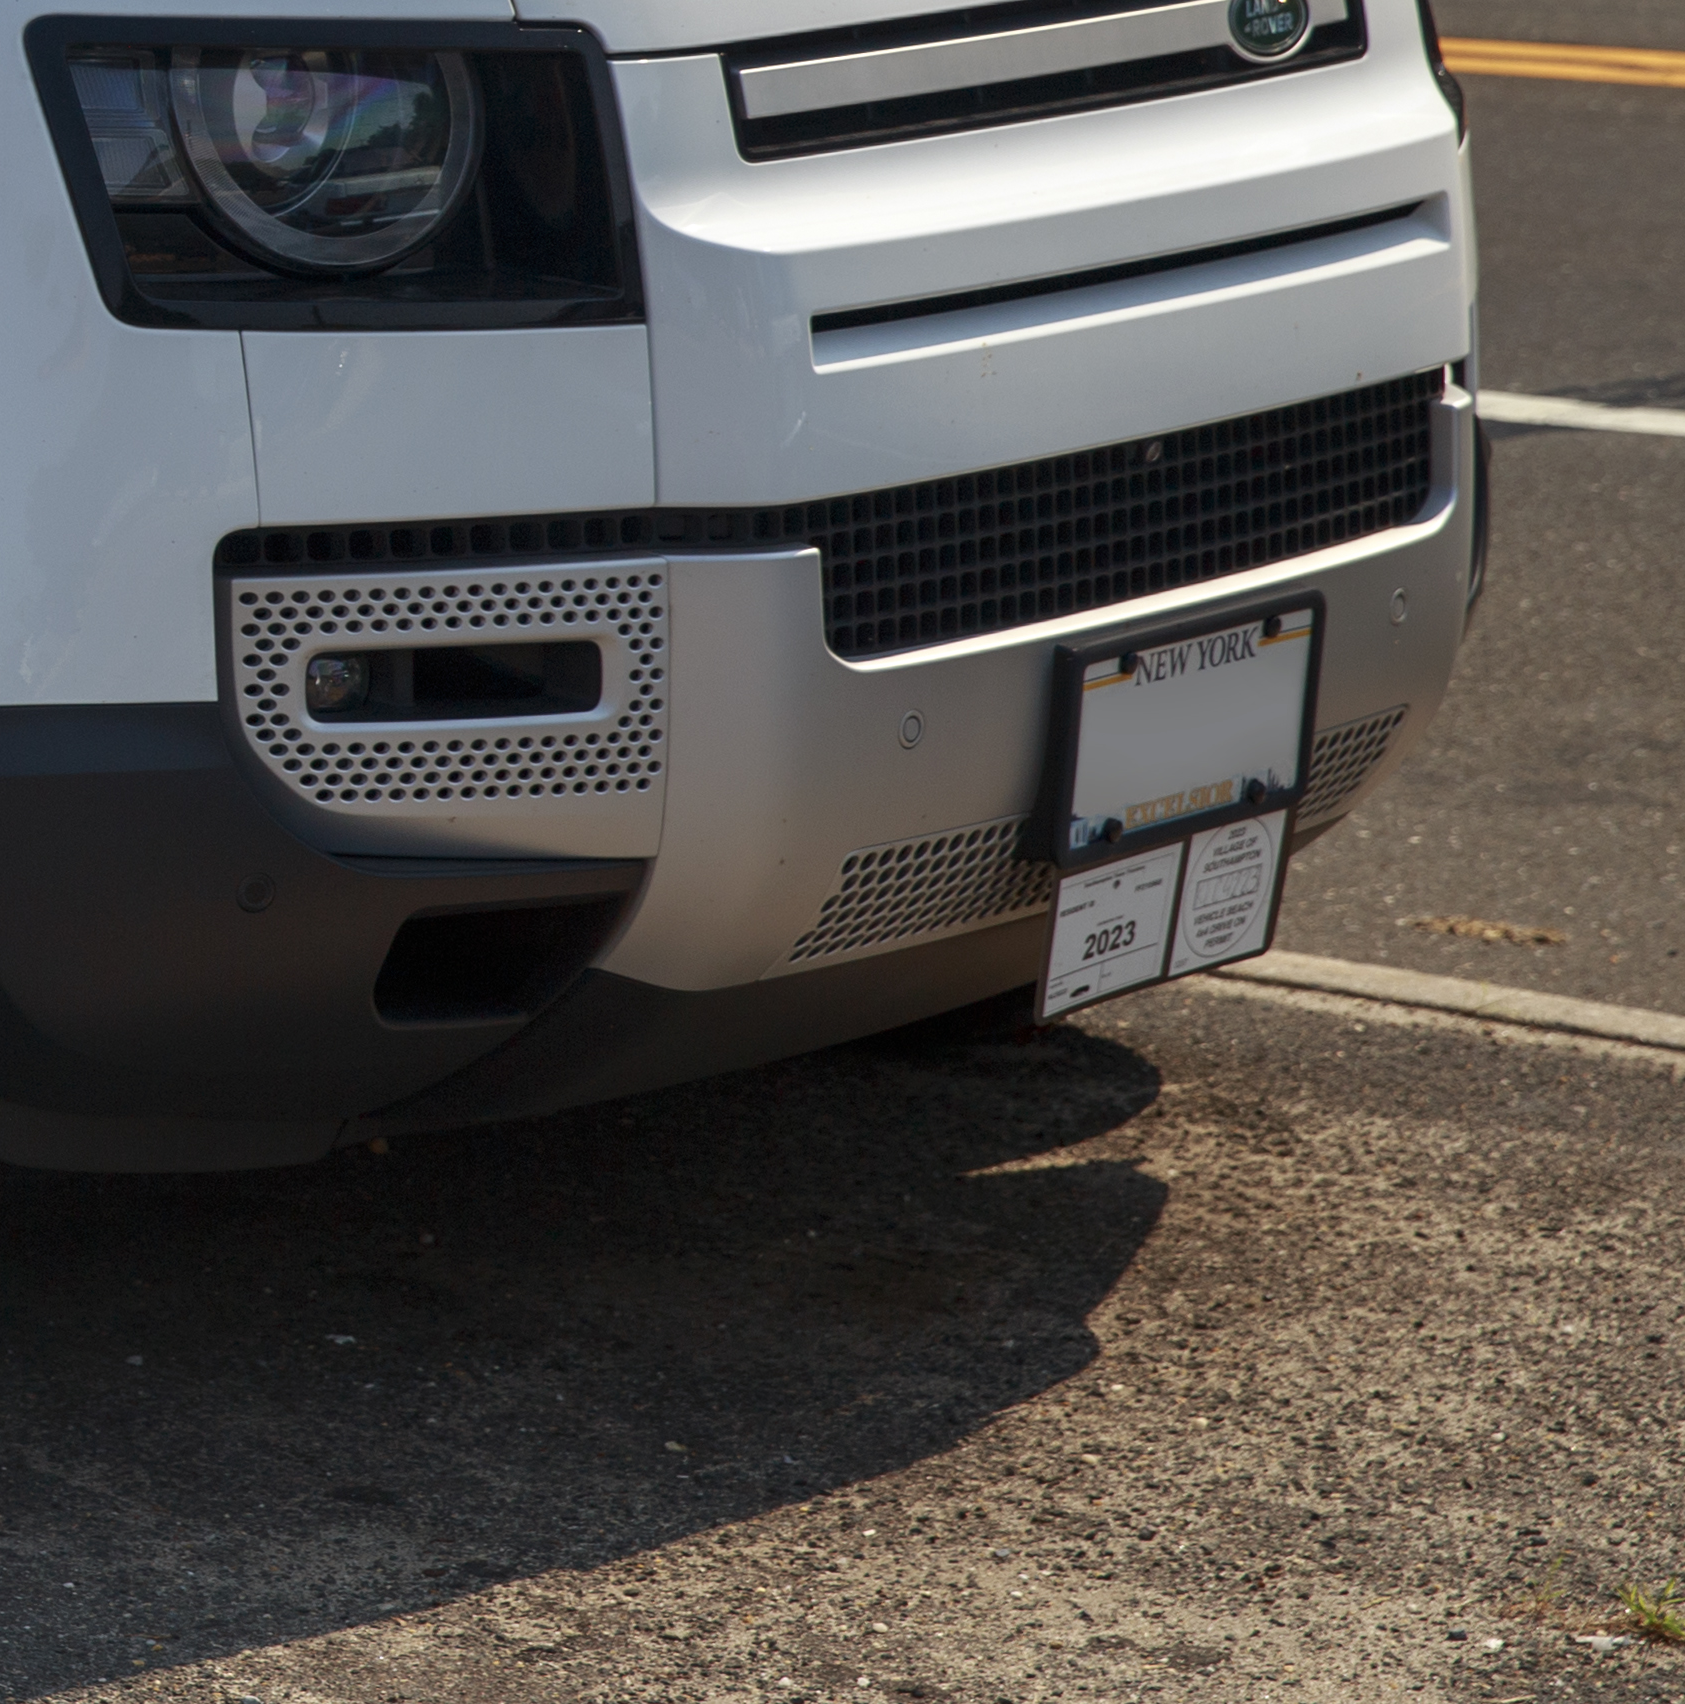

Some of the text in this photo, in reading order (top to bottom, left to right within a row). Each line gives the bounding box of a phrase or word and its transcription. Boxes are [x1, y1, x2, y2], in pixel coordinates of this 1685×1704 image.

[1252, 11, 1293, 37] ROVER
[1135, 626, 1260, 686] NEW YORK
[1125, 779, 1233, 828] EXCELSIOR
[1213, 836, 1258, 856] VILLAGE OF
[1203, 848, 1261, 873] SOUTHAMPTON
[1194, 908, 1226, 926] VEHICLE
[1082, 920, 1136, 961] 2023
